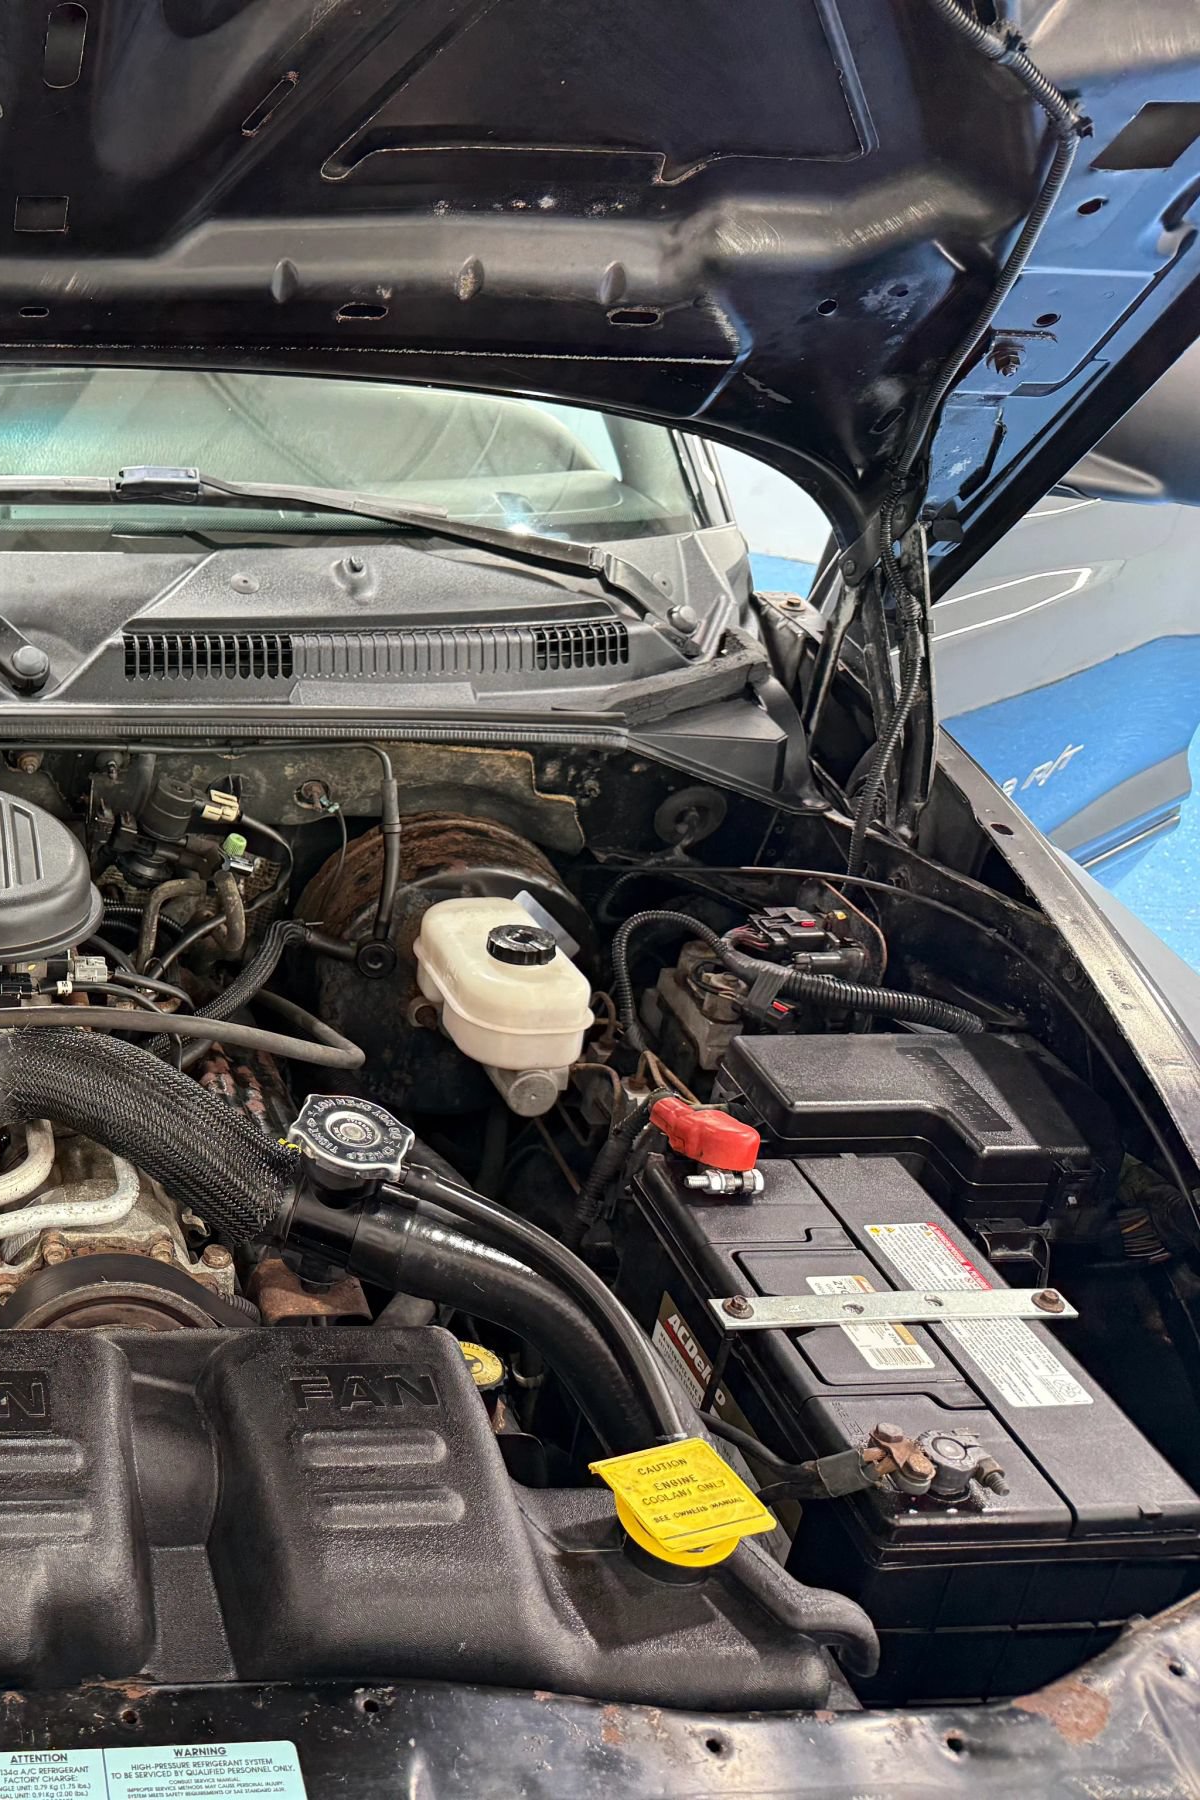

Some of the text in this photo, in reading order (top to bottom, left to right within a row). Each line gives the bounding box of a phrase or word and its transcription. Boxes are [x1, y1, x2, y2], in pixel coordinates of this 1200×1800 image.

[289, 1374, 441, 1411] FAN
[637, 1457, 688, 1476] CAUTION
[653, 1474, 699, 1491] ENGINE
[642, 1479, 727, 1506] COOLANT ONLY
[653, 1514, 671, 1524] SEE
[711, 1496, 745, 1509] MANUAL
[10, 1753, 68, 1764] ATTENTION
[173, 1746, 227, 1757] WARNING
[20, 1767, 37, 1776] A/C
[38, 1765, 89, 1775] REFRIGERANT
[111, 1772, 122, 1780] TO
[134, 1770, 173, 1779] SERVICED
[174, 1769, 185, 1777] BY
[186, 1767, 226, 1777] QUALIFIED
[227, 1765, 272, 1775] PERSONNEL
[272, 1764, 296, 1773] ONLY.
[131, 1758, 273, 1771] HIGH-PRESSURE REFRIGERANT SYSTEM
[4, 1774, 78, 1784] FACTORY CHARGE:
